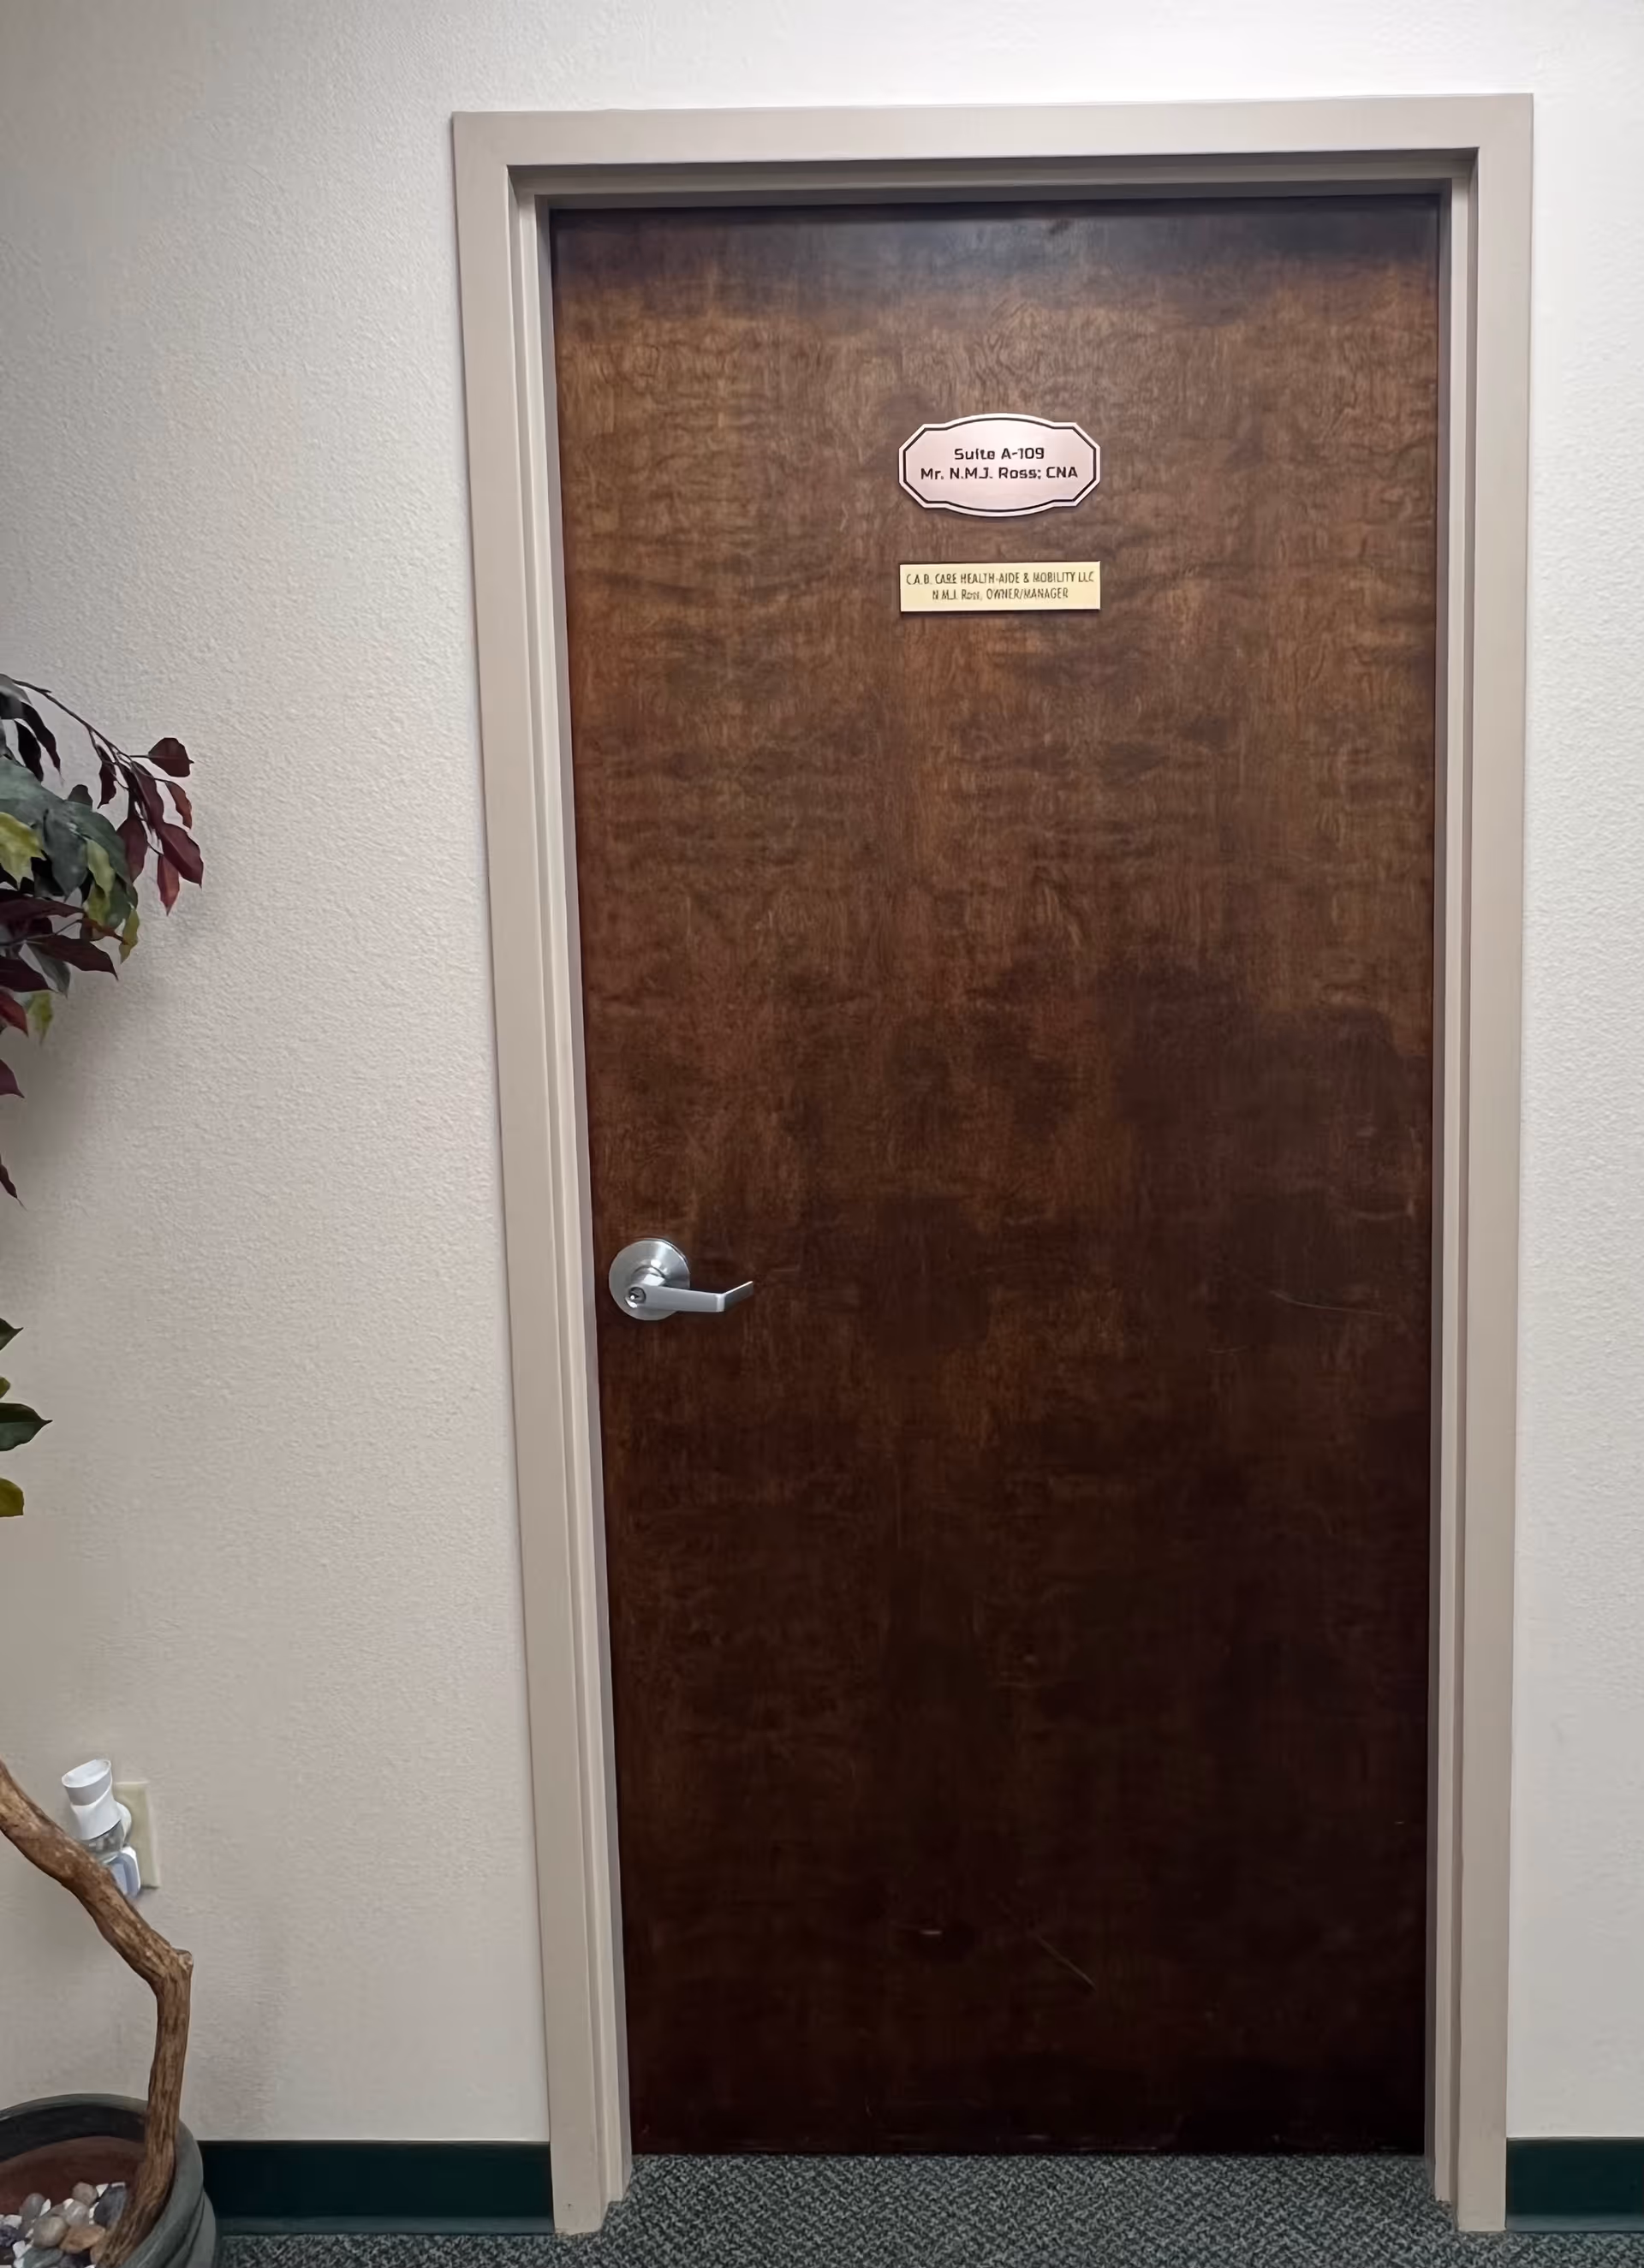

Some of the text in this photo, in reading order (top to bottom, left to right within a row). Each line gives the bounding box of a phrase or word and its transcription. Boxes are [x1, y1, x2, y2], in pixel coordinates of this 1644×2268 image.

[954, 447, 1045, 460] Suite A-109
[920, 467, 944, 480] Mr.
[950, 467, 993, 480] N.M.J.
[1045, 466, 1079, 479] CNA
[934, 573, 958, 585] CARE
[1022, 572, 1030, 584] &
[1032, 571, 1075, 584] MOBILITY
[1077, 570, 1095, 583] LLC
[986, 587, 1069, 600] OWNER/MANAGER
